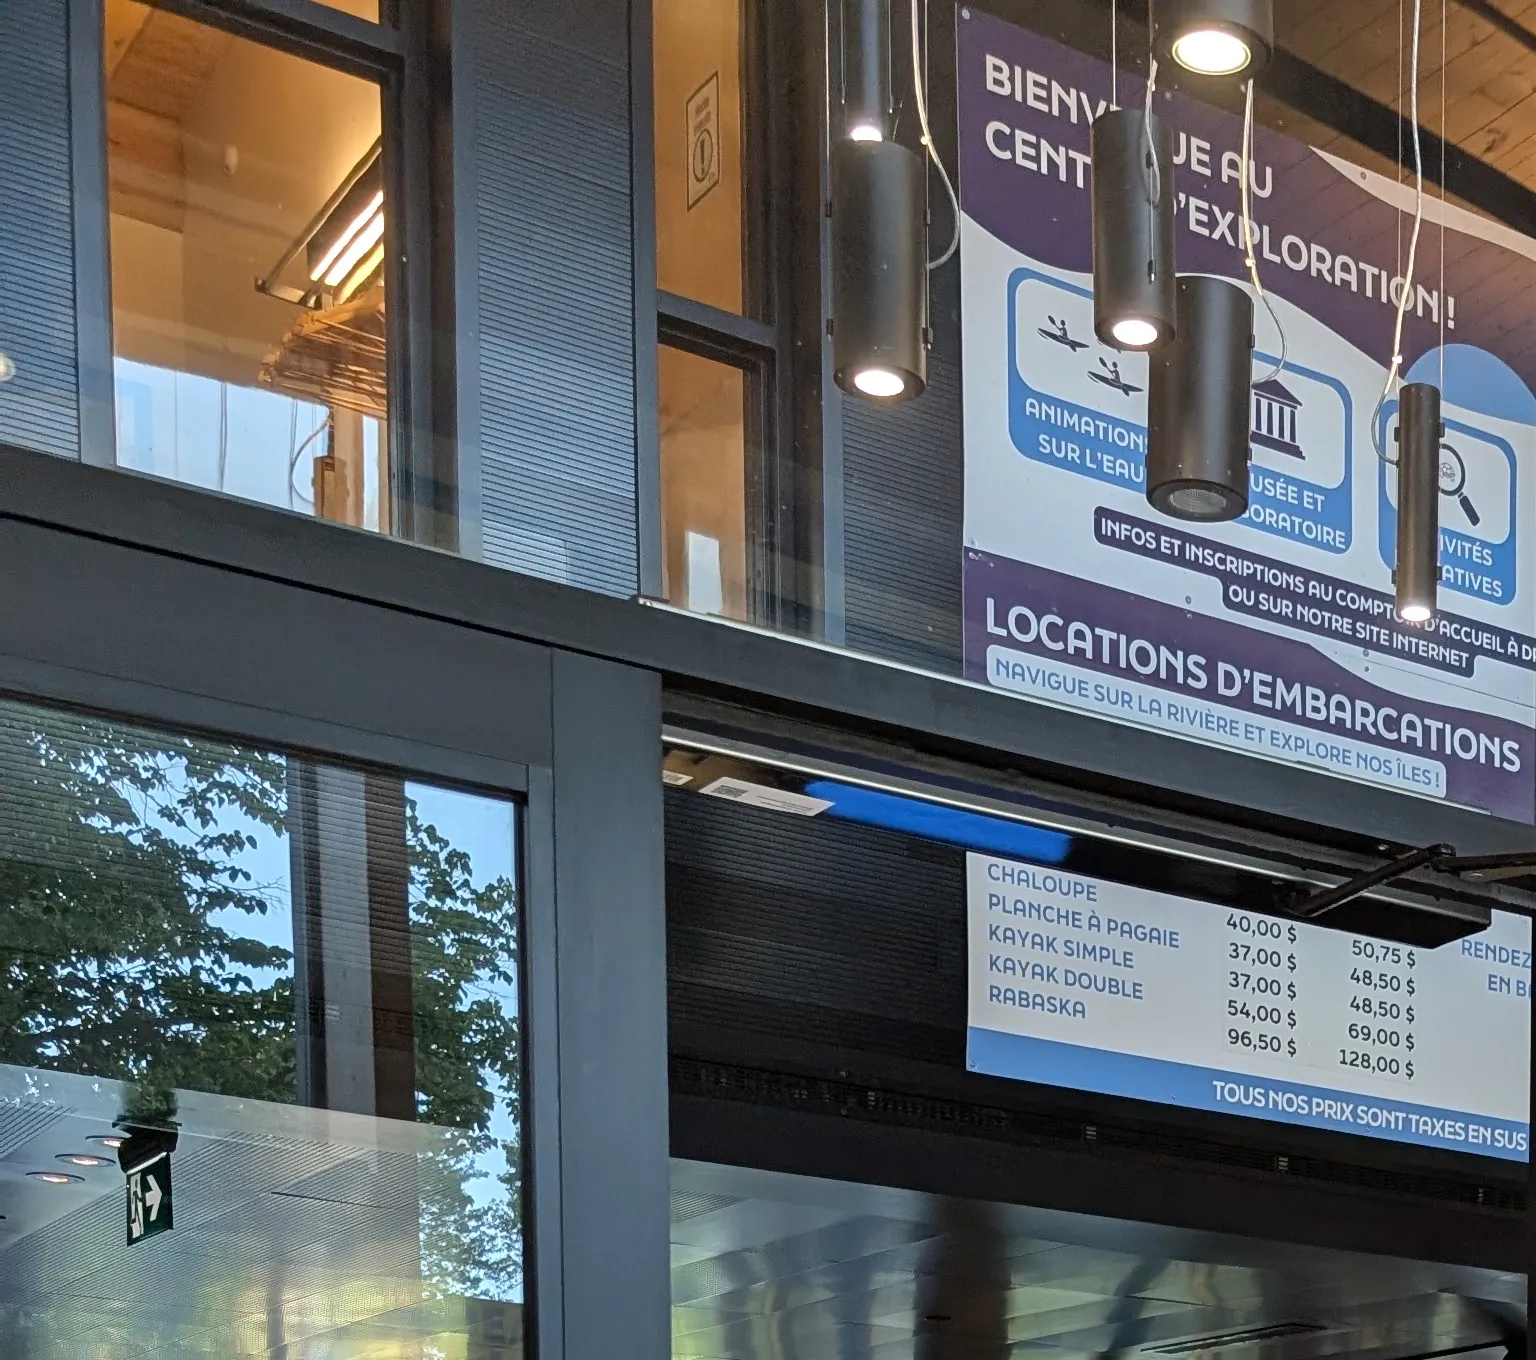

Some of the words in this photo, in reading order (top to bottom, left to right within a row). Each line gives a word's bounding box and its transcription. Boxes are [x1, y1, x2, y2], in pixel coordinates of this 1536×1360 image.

[985, 53, 1212, 178] BIENVUE
[1221, 151, 1273, 199] AU
[985, 120, 1092, 189] CENT
[1173, 191, 1439, 324] 'EXPLORATION
[1038, 434, 1081, 465] SUR
[1085, 448, 1145, 484] L'EAU
[1250, 476, 1298, 504] USÉE
[1303, 490, 1325, 512] ET
[1242, 502, 1347, 550] ORATOIRE
[1440, 534, 1493, 567] IVITÉS
[1101, 517, 1157, 550] INFOS
[1160, 538, 1182, 562] ET
[1185, 543, 1305, 594] INSCRIPTIONS
[1308, 579, 1332, 601] AU
[1507, 635, 1519, 658] À
[1441, 564, 1503, 598] ATIVES
[1228, 584, 1255, 607] OU
[1258, 595, 1293, 619] SUR
[1296, 605, 1353, 636] NOTRE
[1355, 620, 1390, 646] SITE
[1393, 632, 1470, 669] INTERNET
[986, 597, 1208, 690] LOCATIONS
[1217, 661, 1521, 773] D'EMBARCATIONS
[995, 657, 1089, 699] NAVIGUE
[1093, 684, 1134, 710] SUR
[1138, 695, 1162, 718] LA
[1167, 702, 1240, 738] RIVIÈRE
[1244, 722, 1266, 744] ET
[1270, 729, 1352, 767] EXPLORE
[1356, 751, 1393, 777] NOS
[1395, 757, 1432, 786] ÎLES
[987, 863, 1098, 903] CHALOUPE
[988, 892, 1083, 930] PLANCHE
[1088, 909, 1101, 933] À
[1106, 918, 1180, 949] PAGAIE
[1226, 913, 1282, 939] 40,00
[1287, 924, 1297, 945] $
[988, 923, 1059, 955] KAYAK
[1063, 939, 1134, 969] SIMPLE
[1228, 942, 1282, 968] 37,00
[1287, 953, 1297, 973] $
[1352, 939, 1402, 965] 50,75
[1406, 950, 1416, 970] $
[1461, 938, 1532, 969] RENDEZ
[989, 953, 1059, 985] KAYAK
[1064, 968, 1144, 1000] DOUBLE
[1228, 971, 1282, 996] 37,00
[1287, 981, 1297, 1001] $
[1349, 967, 1401, 992] 48,50
[1406, 977, 1416, 997] $
[1487, 973, 1511, 995] EN
[989, 984, 1086, 1019] RABASKA
[1227, 999, 1282, 1025] 54,00
[1287, 1009, 1297, 1030] $
[1349, 995, 1401, 1020] 48,50
[1406, 1005, 1415, 1025] $
[1227, 1028, 1282, 1053] 96,50
[1287, 1037, 1297, 1058] $
[1348, 1023, 1400, 1047] 69,00
[1405, 1032, 1415, 1052] $
[1339, 1049, 1400, 1075] 128,00
[1405, 1060, 1415, 1080] $
[1212, 1080, 1266, 1107] TOUS
[1268, 1090, 1309, 1114] NOS
[1312, 1098, 1354, 1123] PRIX
[1357, 1105, 1406, 1130] SONT
[1408, 1113, 1465, 1141] TAXES
[1468, 1124, 1492, 1144] EN
[1494, 1129, 1528, 1152] SUS
